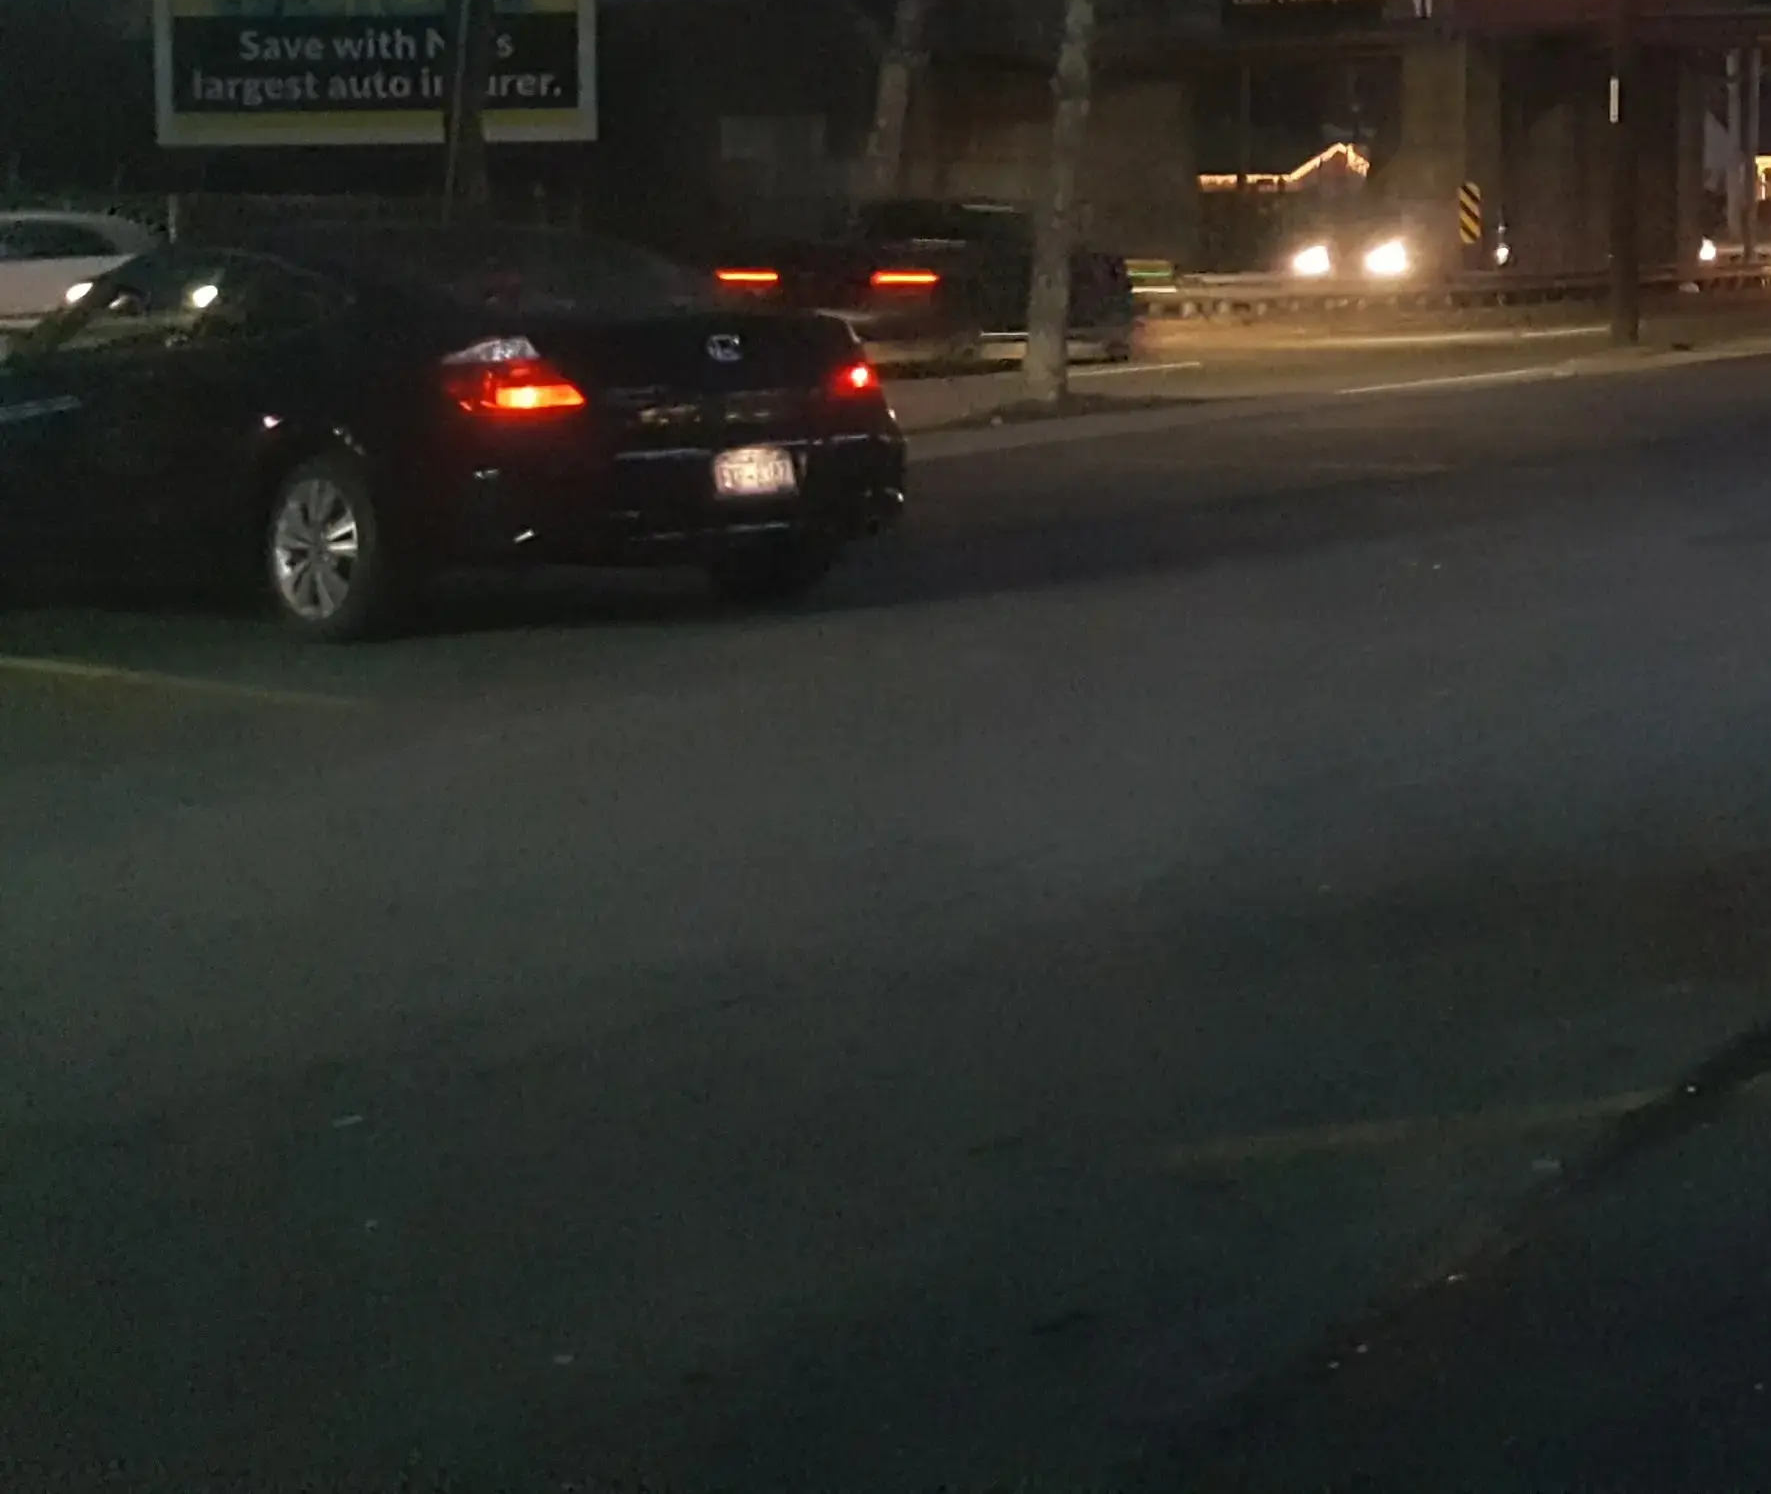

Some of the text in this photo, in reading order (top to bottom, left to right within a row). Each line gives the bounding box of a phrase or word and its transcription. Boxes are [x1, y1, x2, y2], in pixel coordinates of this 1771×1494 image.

[239, 29, 326, 61] Save
[332, 26, 417, 60] with
[192, 69, 321, 106] largest
[328, 68, 414, 98] auto
